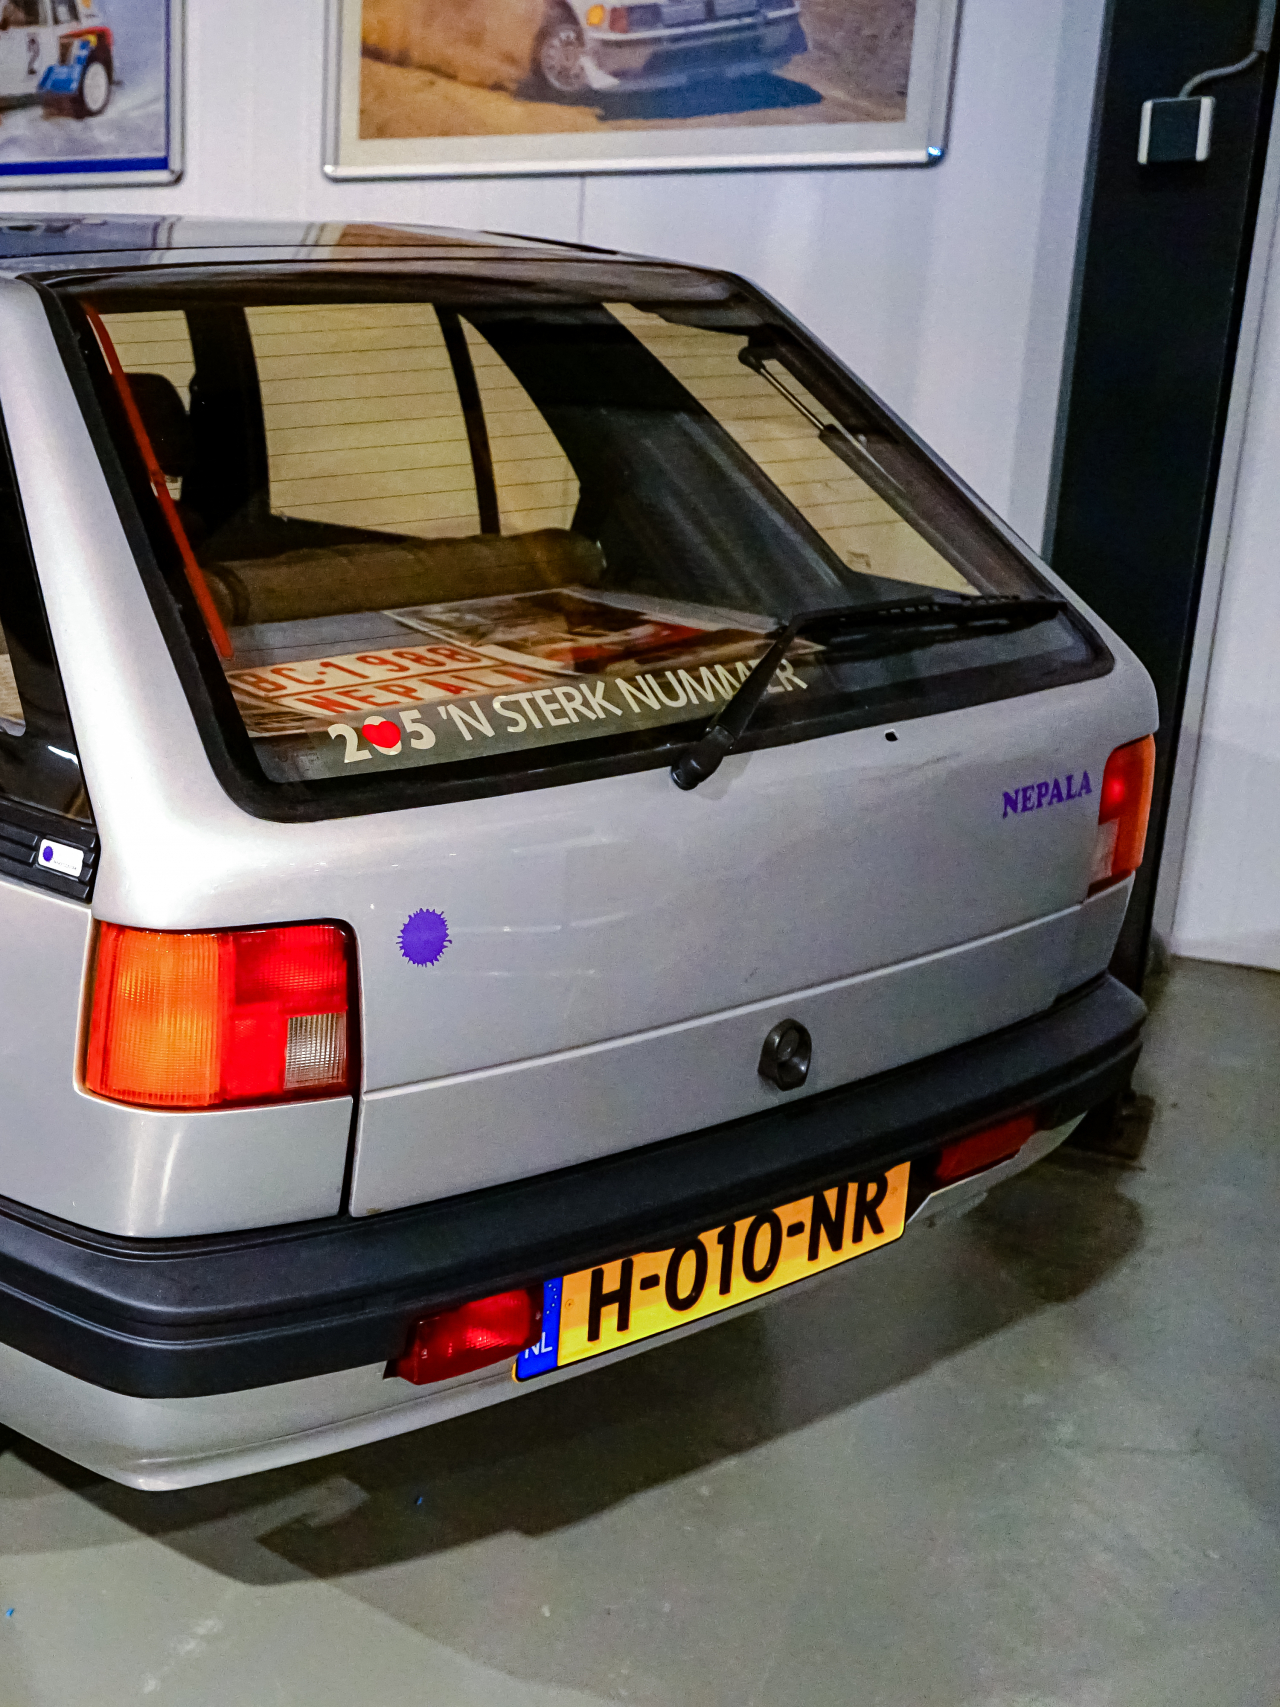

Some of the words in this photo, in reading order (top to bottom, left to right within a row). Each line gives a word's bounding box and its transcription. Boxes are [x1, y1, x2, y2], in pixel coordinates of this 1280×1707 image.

[493, 681, 624, 735] STERK
[1002, 770, 1093, 819] NEPALA
[587, 1172, 890, 1343] H-010-NR
